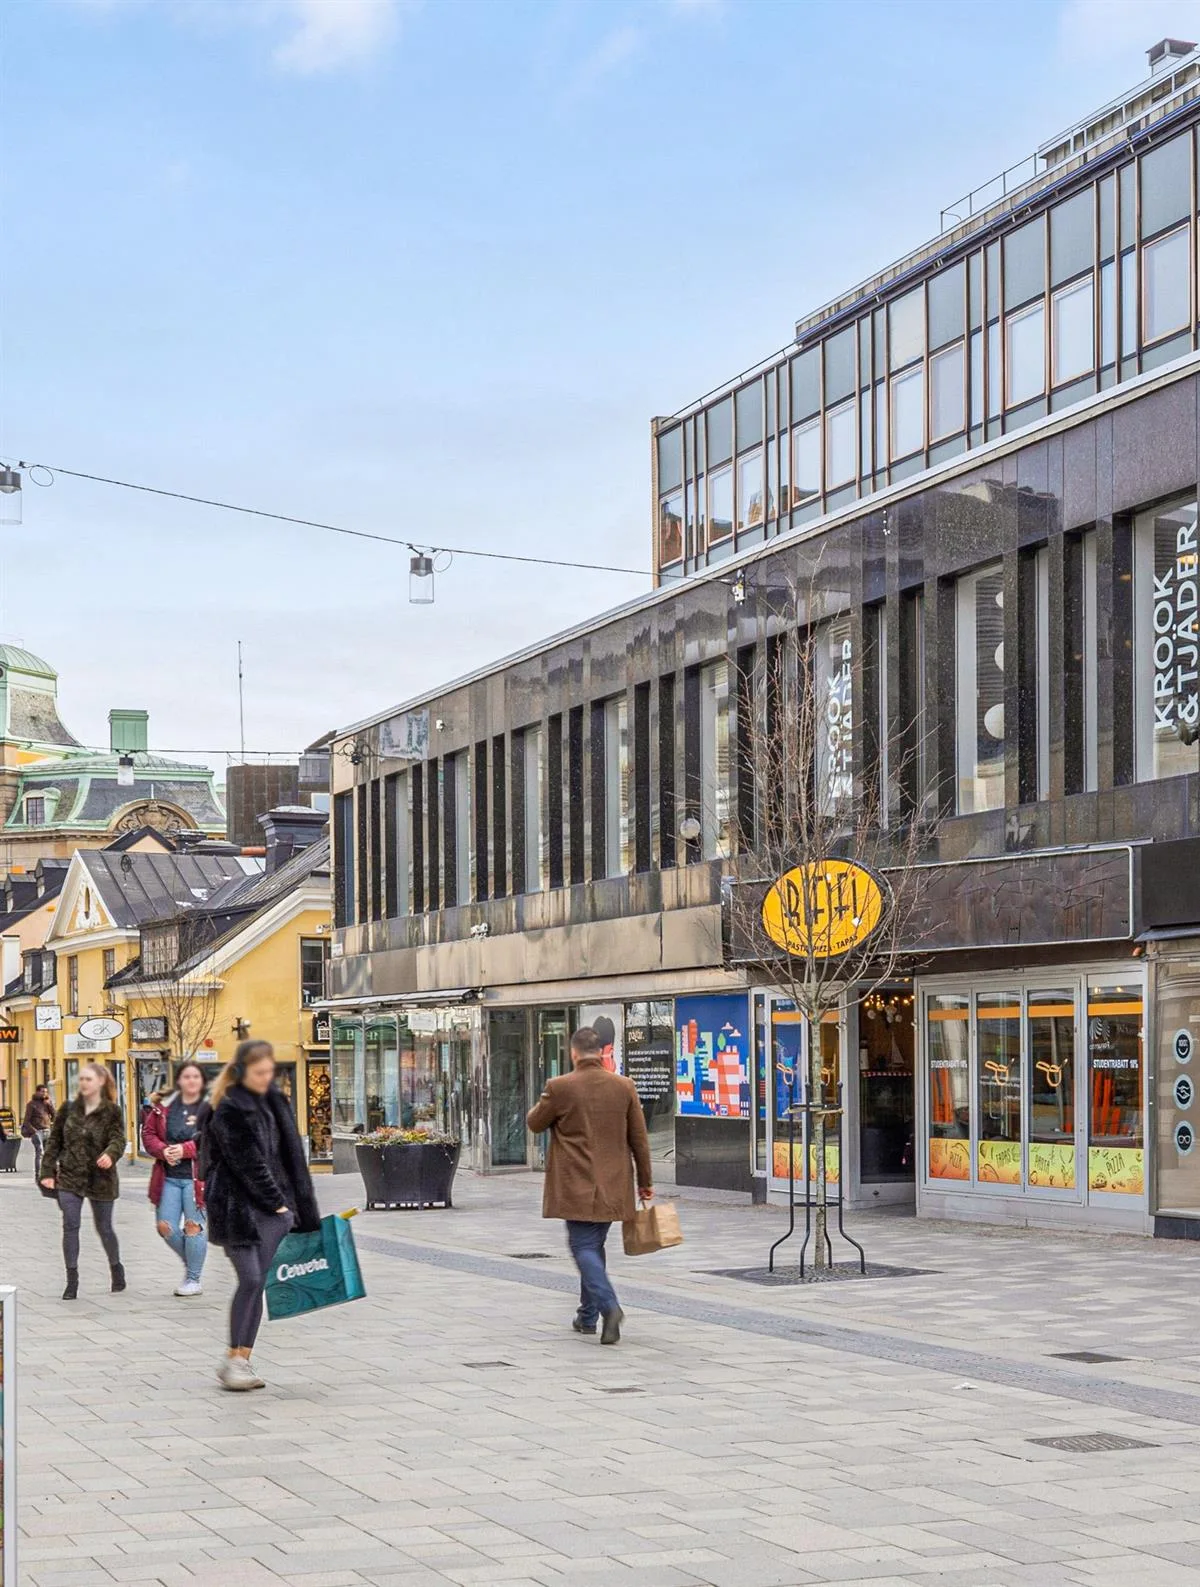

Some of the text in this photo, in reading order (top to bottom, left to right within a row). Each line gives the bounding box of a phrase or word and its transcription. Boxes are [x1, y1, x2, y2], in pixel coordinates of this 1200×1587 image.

[1172, 520, 1199, 724] & TJÄDER
[1153, 567, 1176, 733] KROOK
[1093, 1059, 1128, 1068] STUDENTRABATT
[1106, 1153, 1126, 1177] PIZZA
[276, 1258, 329, 1281] Cervera
